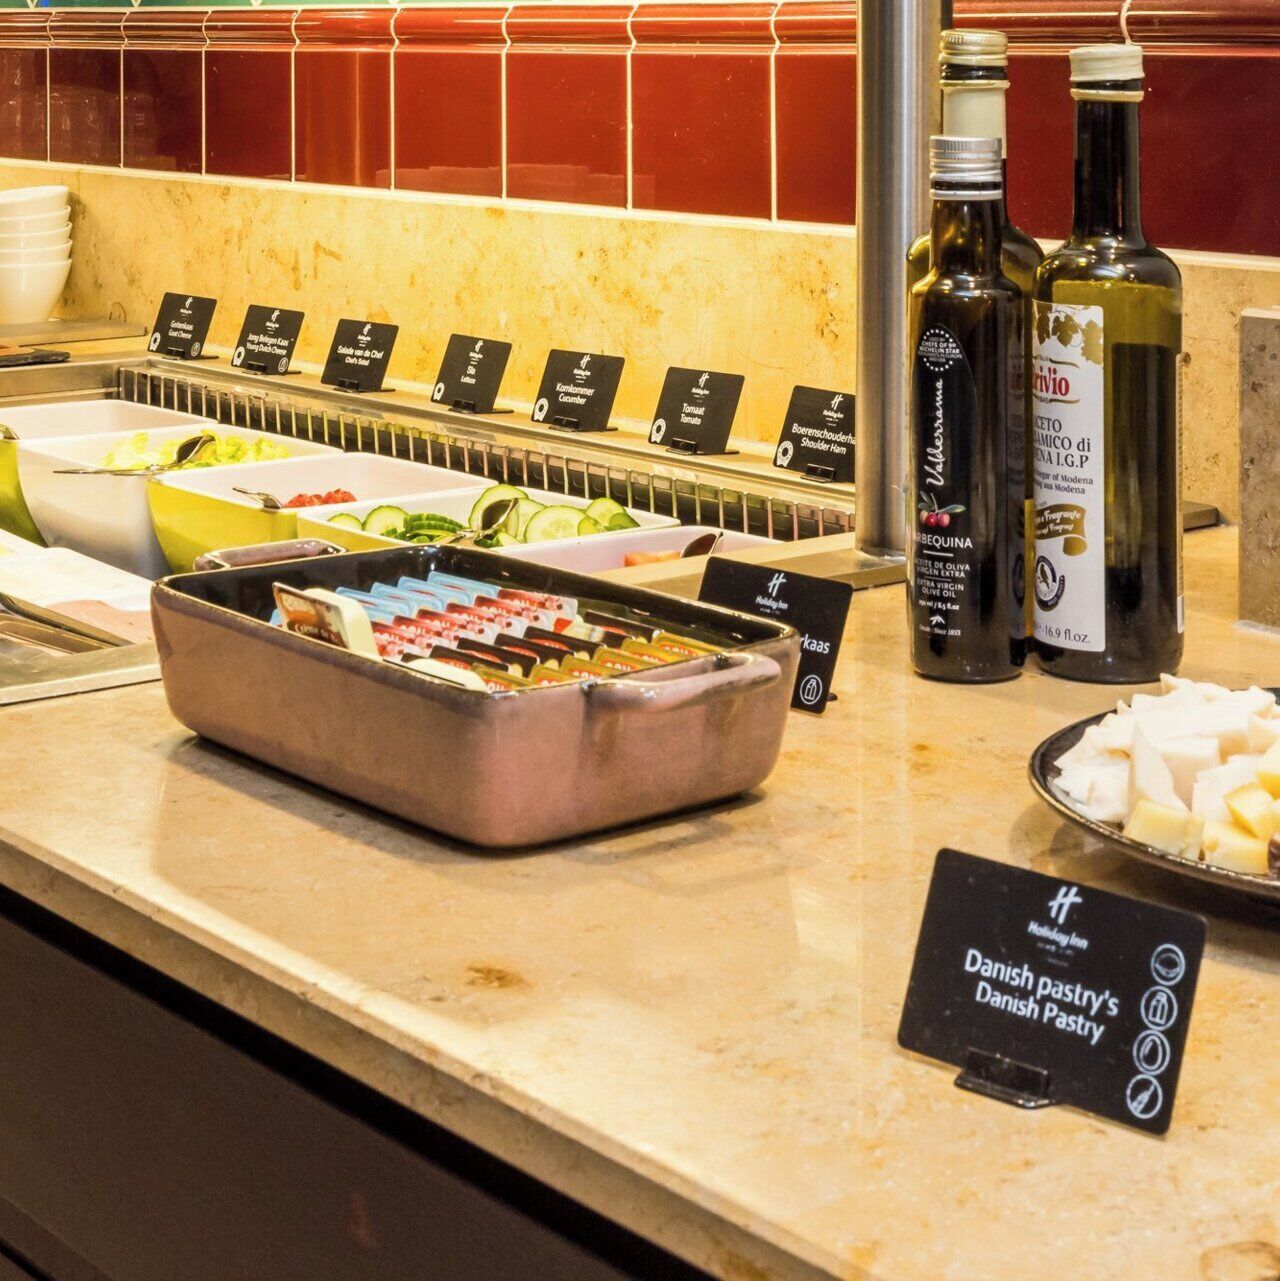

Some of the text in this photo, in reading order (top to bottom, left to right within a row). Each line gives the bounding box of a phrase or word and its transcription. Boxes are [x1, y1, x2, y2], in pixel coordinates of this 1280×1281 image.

[558, 393, 587, 405] Cucumber
[682, 403, 705, 415] Tomaat
[680, 414, 702, 425] Tomato
[1035, 415, 1062, 433] CETO
[791, 423, 856, 445] Boerenschouderha
[801, 437, 847, 455] Shoulder Ham
[1076, 438, 1091, 452] di
[1052, 473, 1059, 481] of
[1061, 474, 1094, 485] Modena
[1055, 483, 1086, 494] Modena
[915, 532, 973, 549] RBEQUINA
[934, 561, 944, 569] DE
[945, 563, 970, 571] OLIVA
[941, 570, 966, 578] EXTRA
[921, 586, 956, 598] OLIVE OIL
[936, 581, 964, 591] VIRGIN
[755, 595, 789, 610] Holiday Inn
[800, 634, 831, 654] rkaas
[1028, 920, 1070, 948] Holiday
[1069, 931, 1089, 950] Inn
[964, 949, 1119, 1017] Danish pastry's
[975, 981, 1105, 1046] Danish Pastry
